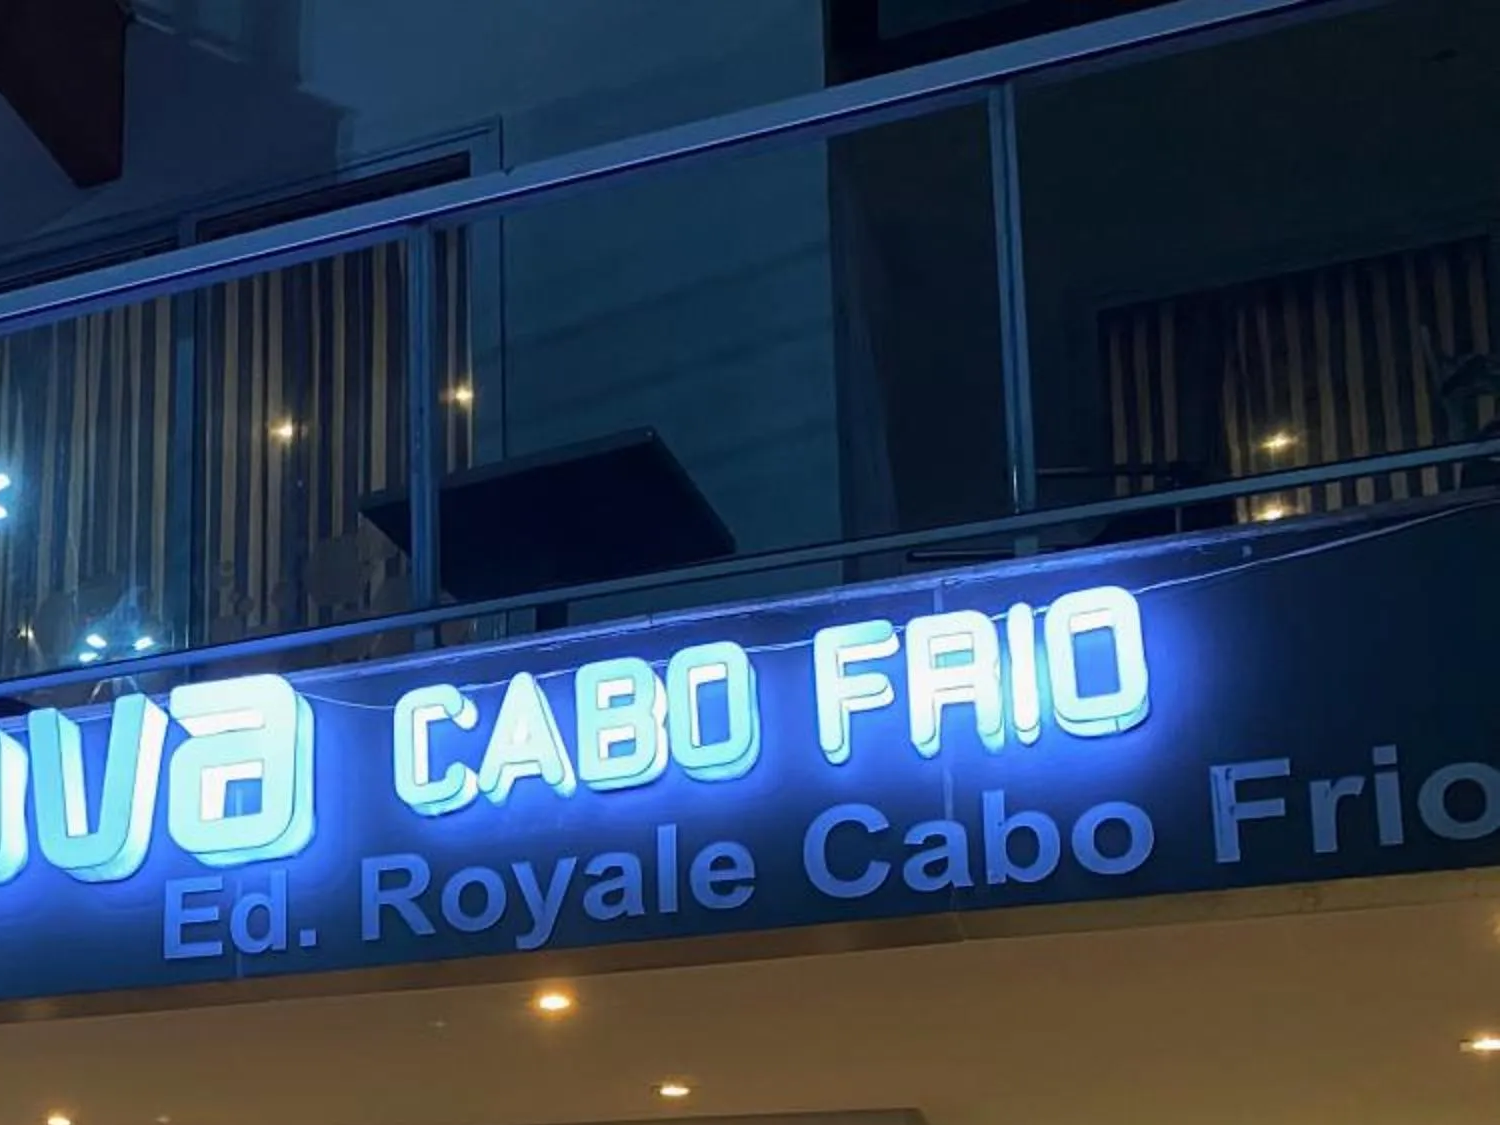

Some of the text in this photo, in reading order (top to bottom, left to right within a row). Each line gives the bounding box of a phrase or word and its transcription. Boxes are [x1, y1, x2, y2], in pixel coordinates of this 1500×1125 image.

[393, 640, 762, 817] CABO
[812, 584, 1152, 766] FRIO
[164, 743, 1500, 960] Ed. Royale Cabo Frio
